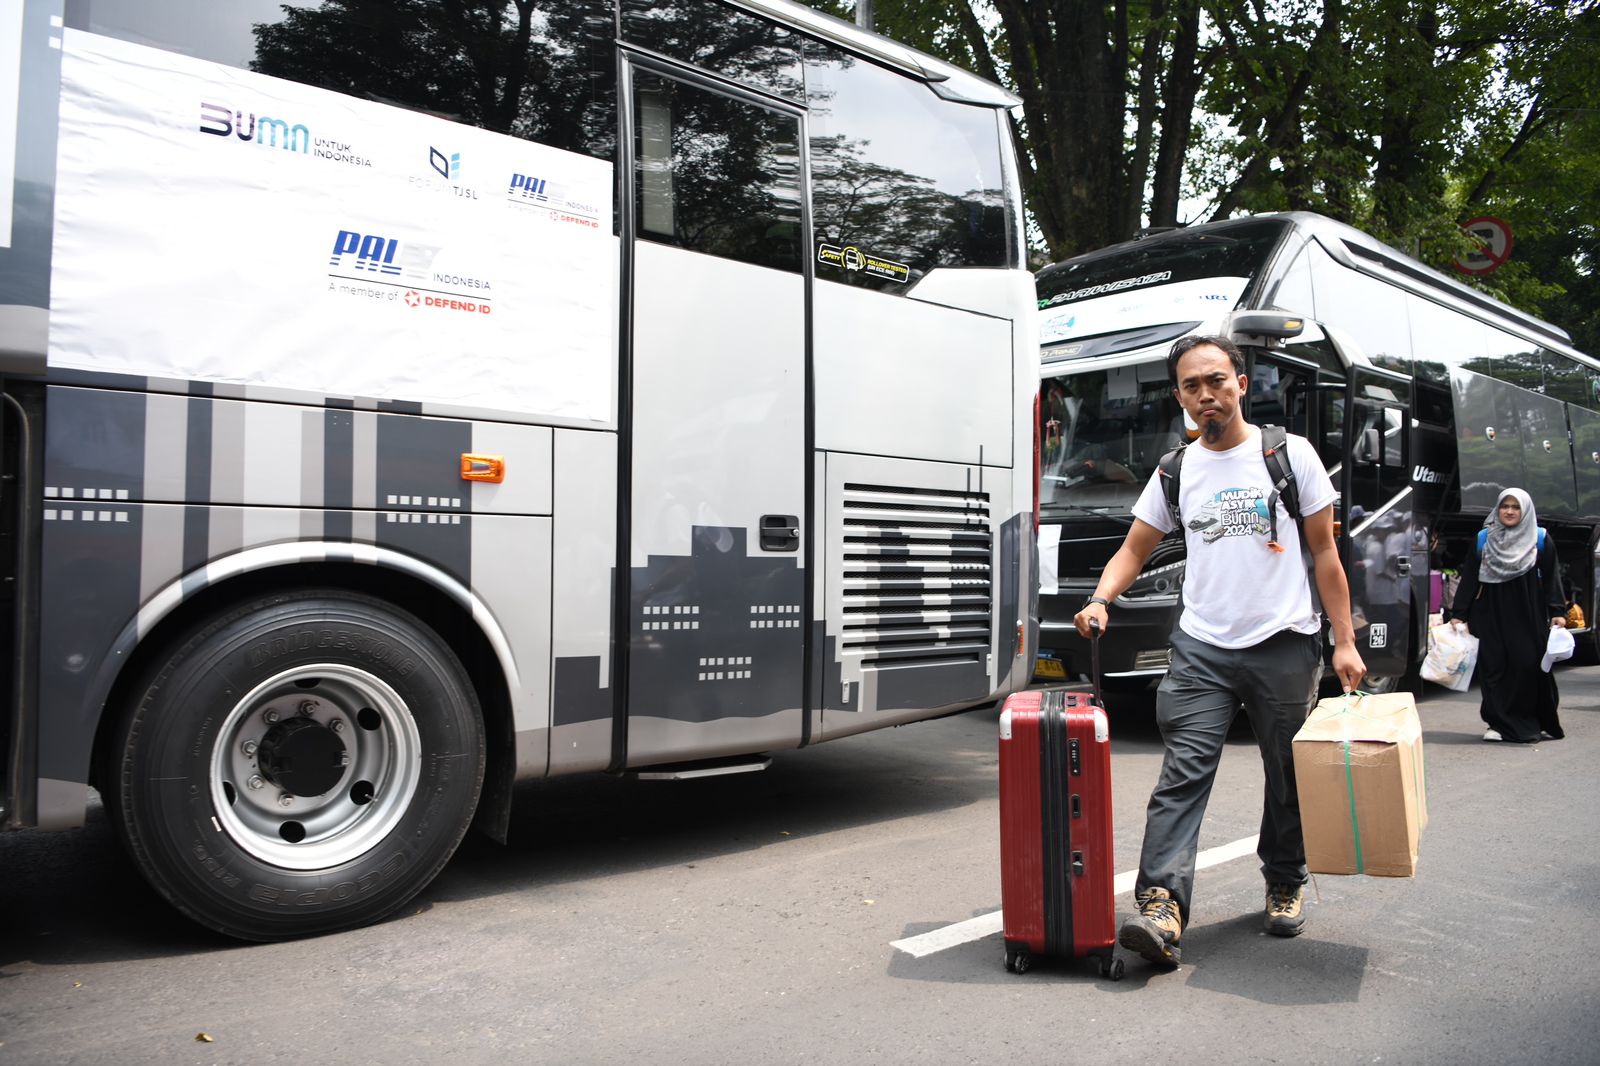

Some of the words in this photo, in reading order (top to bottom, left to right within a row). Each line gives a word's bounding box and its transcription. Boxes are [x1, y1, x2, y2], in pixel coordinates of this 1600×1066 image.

[314, 137, 352, 152] UNTUK
[314, 148, 372, 167] INDONESIA
[565, 201, 599, 213] INDONESIA
[561, 214, 590, 227] DEFEND
[591, 221, 599, 229] ID
[329, 230, 402, 276] PAL
[821, 249, 841, 261] SAFETY
[867, 259, 891, 269] ROLLOVER
[891, 265, 907, 274] TESTED
[433, 273, 491, 290] INDONESIA
[1048, 270, 1172, 305] PARIWISATA
[328, 282, 336, 292] A
[340, 284, 385, 301] member
[387, 290, 399, 301] of
[425, 296, 476, 312] DEFEND
[479, 304, 491, 315] ID
[1221, 499, 1257, 511] ASYIK
[1221, 511, 1259, 526] BUMN
[1223, 525, 1254, 537] 2024
[1372, 635, 1384, 645] 26
[247, 629, 417, 678] BRIDGESTONE
